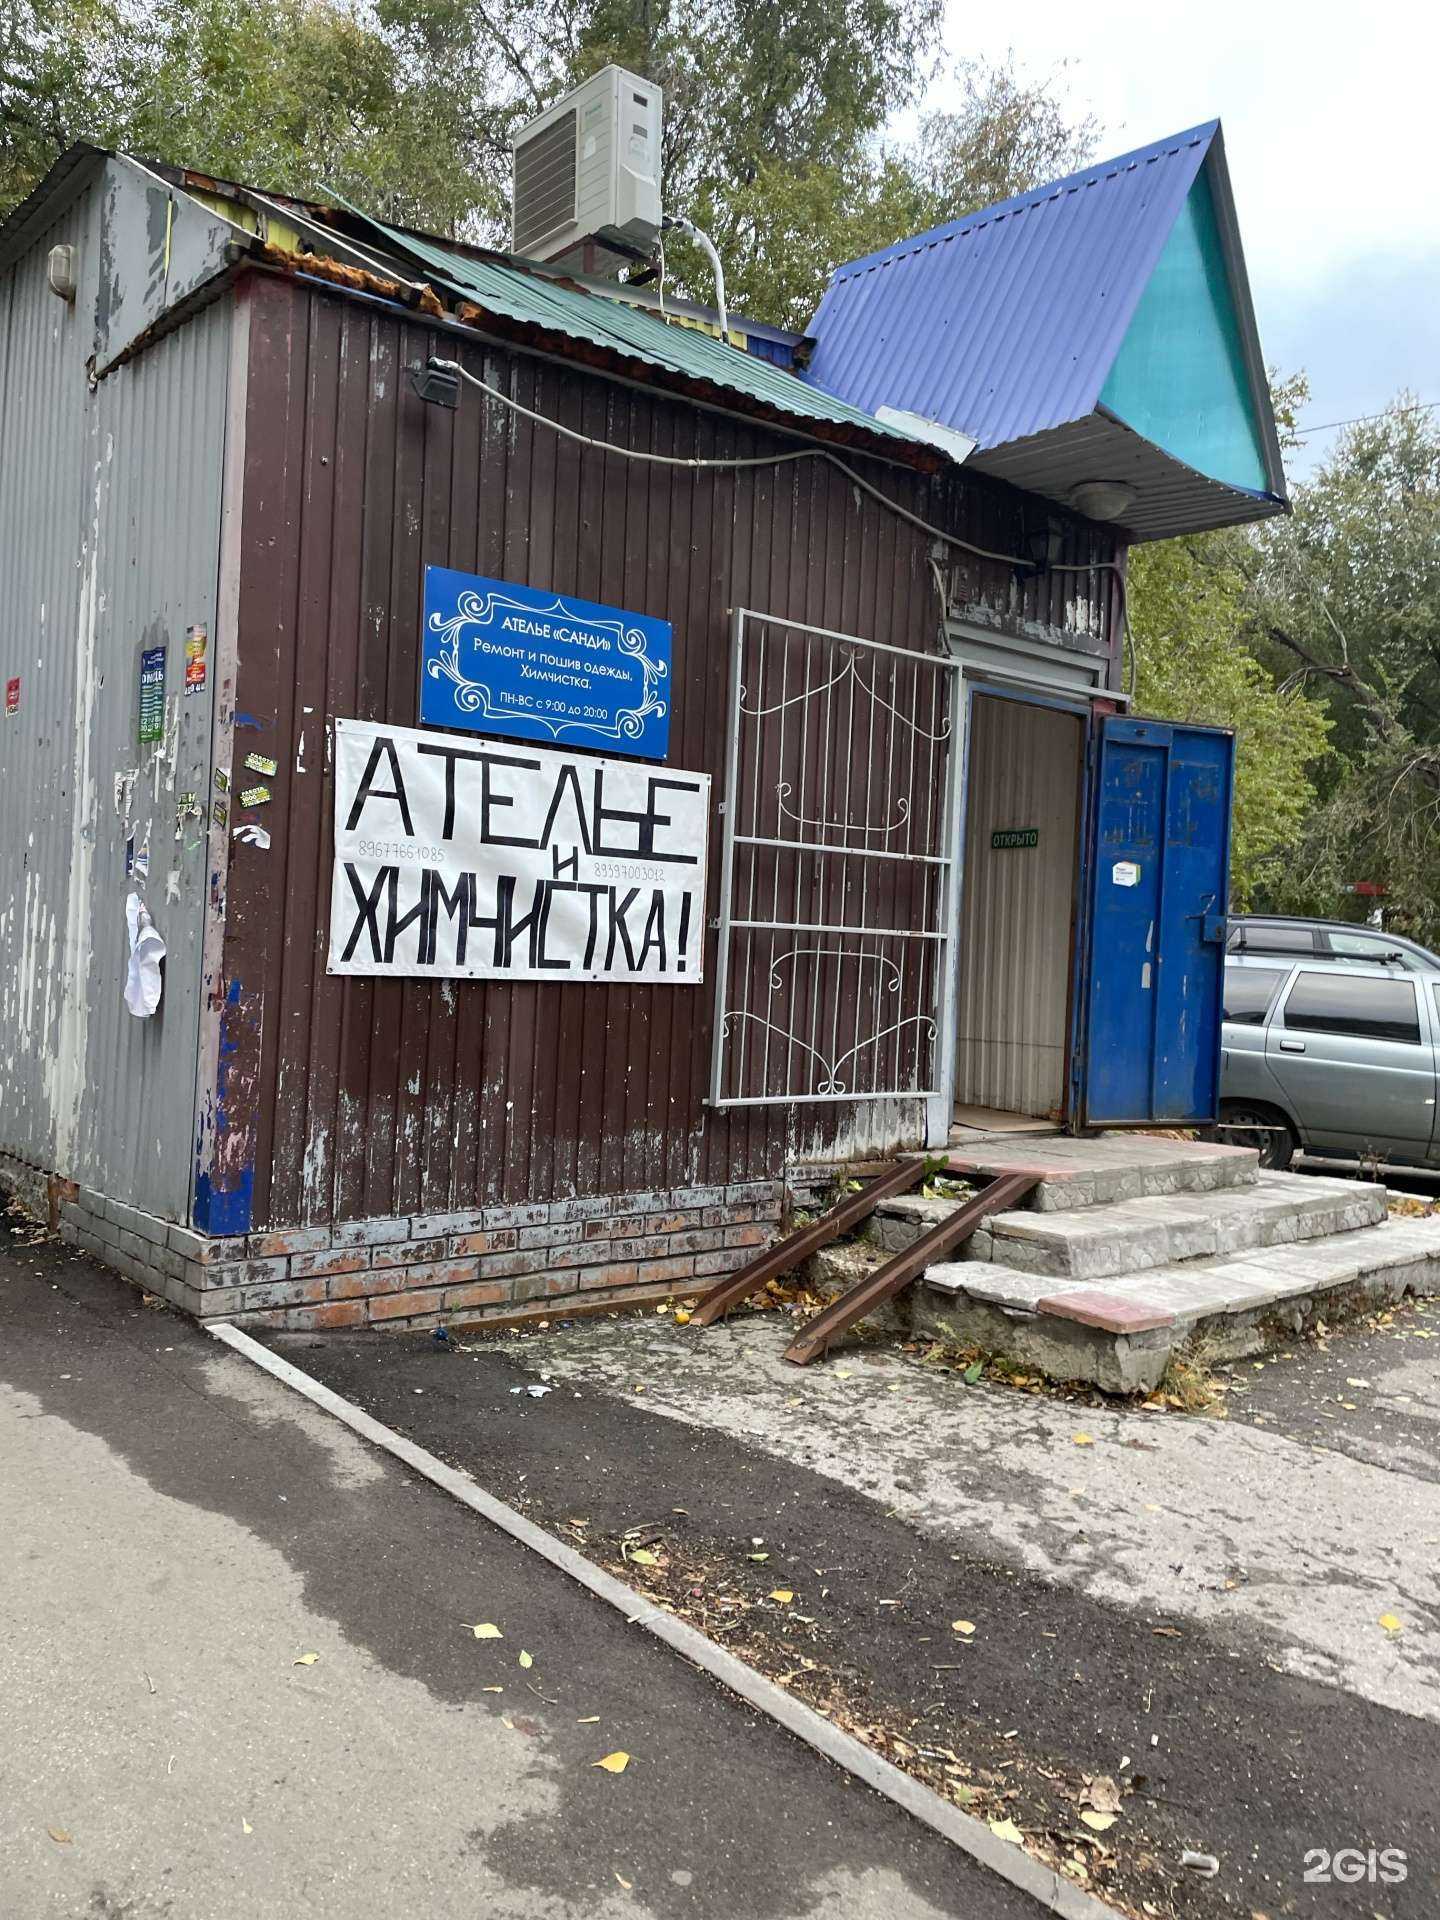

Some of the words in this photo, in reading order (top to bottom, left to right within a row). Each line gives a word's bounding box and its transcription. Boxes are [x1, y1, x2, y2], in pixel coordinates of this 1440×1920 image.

[501, 617, 550, 638] АТЕЛЬЕ
[553, 628, 611, 651] «САНДИ»
[474, 638, 525, 659] Ремонт
[528, 652, 536, 662] и
[540, 653, 581, 670] пошив
[584, 663, 633, 681] одежды.
[520, 665, 592, 689] Химчистка.
[500, 692, 533, 707] ПН-ВС
[536, 700, 543, 709] с
[545, 701, 566, 713] 9:00
[568, 705, 581, 715] до
[583, 706, 608, 720] 20:00
[345, 736, 700, 864] АТЕЛЬЕ
[993, 832, 1037, 848] ОТКРЫТО
[340, 862, 692, 972] ХИМЧИСТКА!
